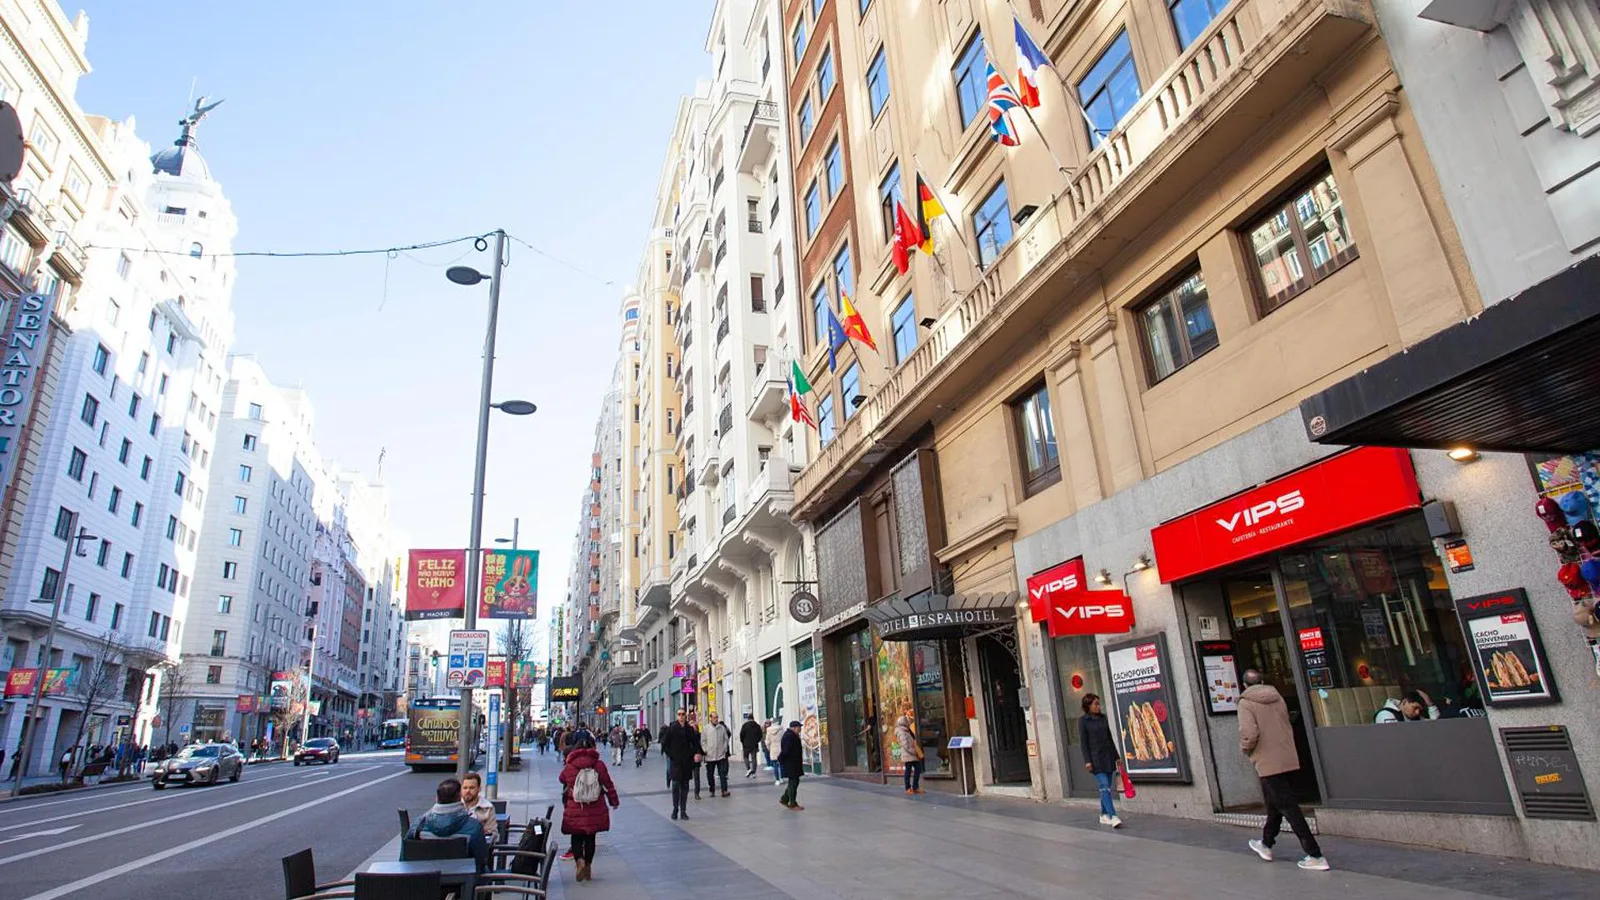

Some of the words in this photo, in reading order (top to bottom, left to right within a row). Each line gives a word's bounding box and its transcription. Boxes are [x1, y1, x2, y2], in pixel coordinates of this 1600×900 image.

[0, 296, 43, 426] SENATOR
[1215, 489, 1305, 532] VIPS
[1259, 518, 1294, 534] RESTAURANTE
[418, 559, 455, 570] FELIZ
[418, 577, 455, 588] CHINO
[1030, 573, 1078, 600] VIPS
[1467, 595, 1516, 610] VIPS
[1056, 604, 1125, 619] VIPS
[882, 617, 908, 634] OTEL
[1476, 634, 1517, 644] BIENVENIDA!
[1113, 666, 1155, 681] CACHOPOWER
[417, 718, 461, 729] CANTANDO
[434, 730, 458, 742] LLUVIA
